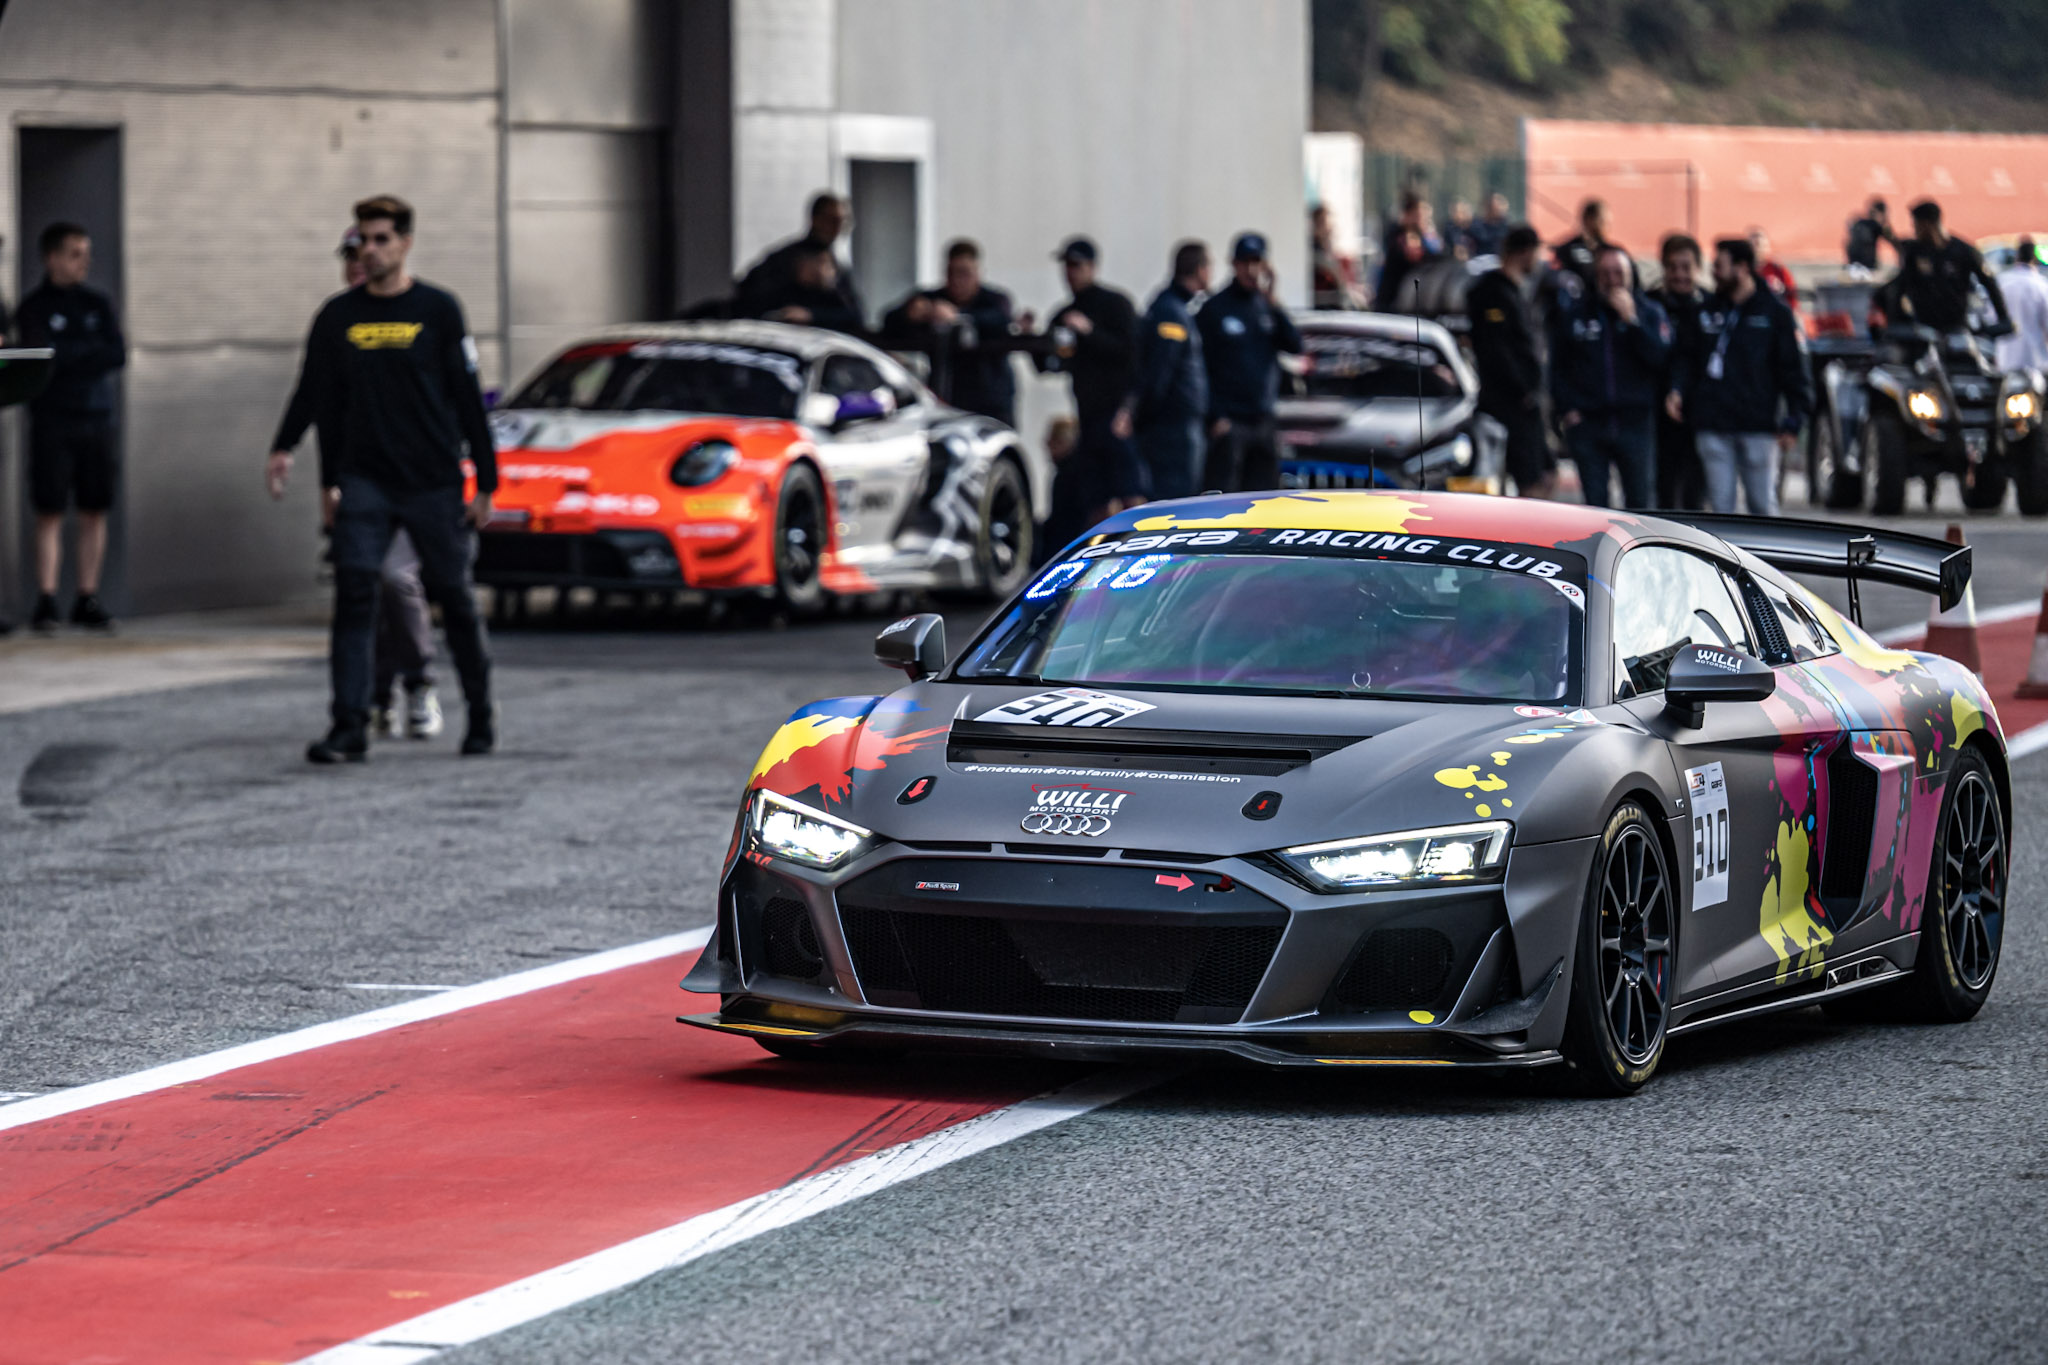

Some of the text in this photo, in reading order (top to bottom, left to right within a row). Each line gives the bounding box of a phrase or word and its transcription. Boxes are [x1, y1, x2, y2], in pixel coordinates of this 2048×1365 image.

[1269, 529, 1441, 555] RACING
[1447, 544, 1563, 579] CLUB
[1695, 658, 1741, 674] MOTORSPORT
[1697, 649, 1743, 670] WILLI
[1036, 789, 1128, 809] WILLI
[1029, 805, 1119, 816] MOTORSPORT
[1694, 808, 1728, 883] 310
